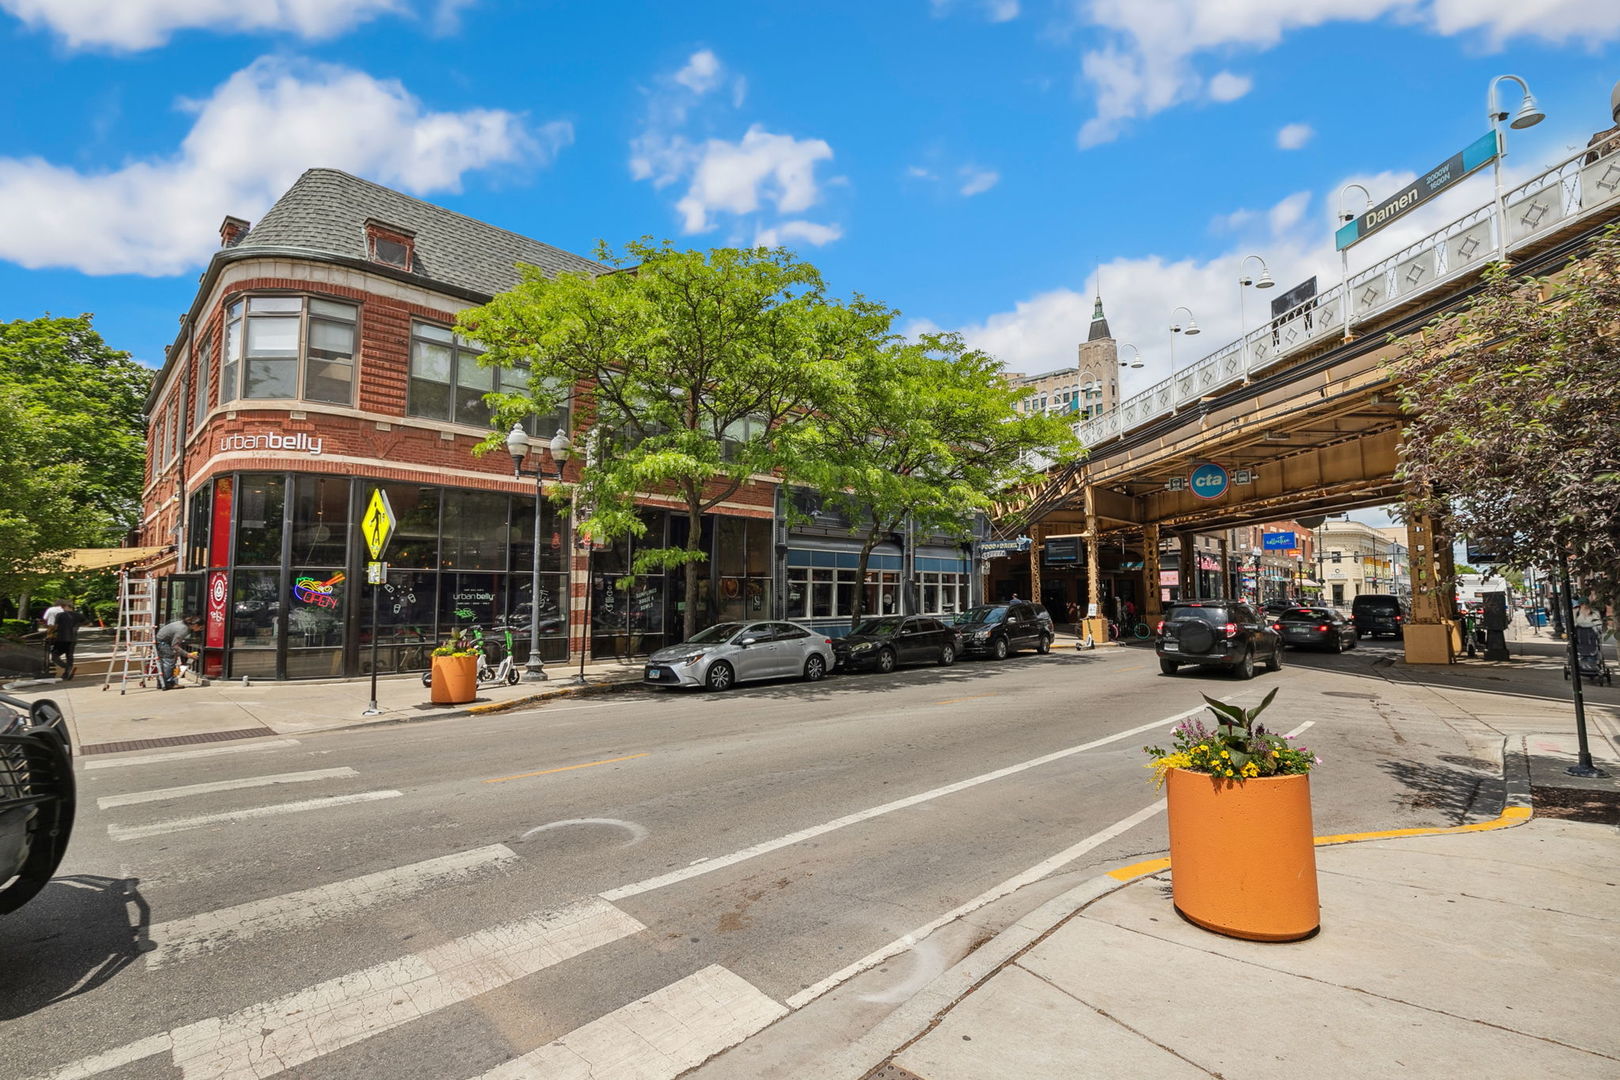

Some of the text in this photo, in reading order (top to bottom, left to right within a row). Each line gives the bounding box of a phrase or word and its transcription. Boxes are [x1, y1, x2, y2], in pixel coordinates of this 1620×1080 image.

[1426, 164, 1450, 184] 2000W
[1366, 187, 1419, 229] Damen
[220, 432, 322, 455] urbanbelly
[1195, 474, 1223, 487] cta
[303, 591, 338, 609] OPEN
